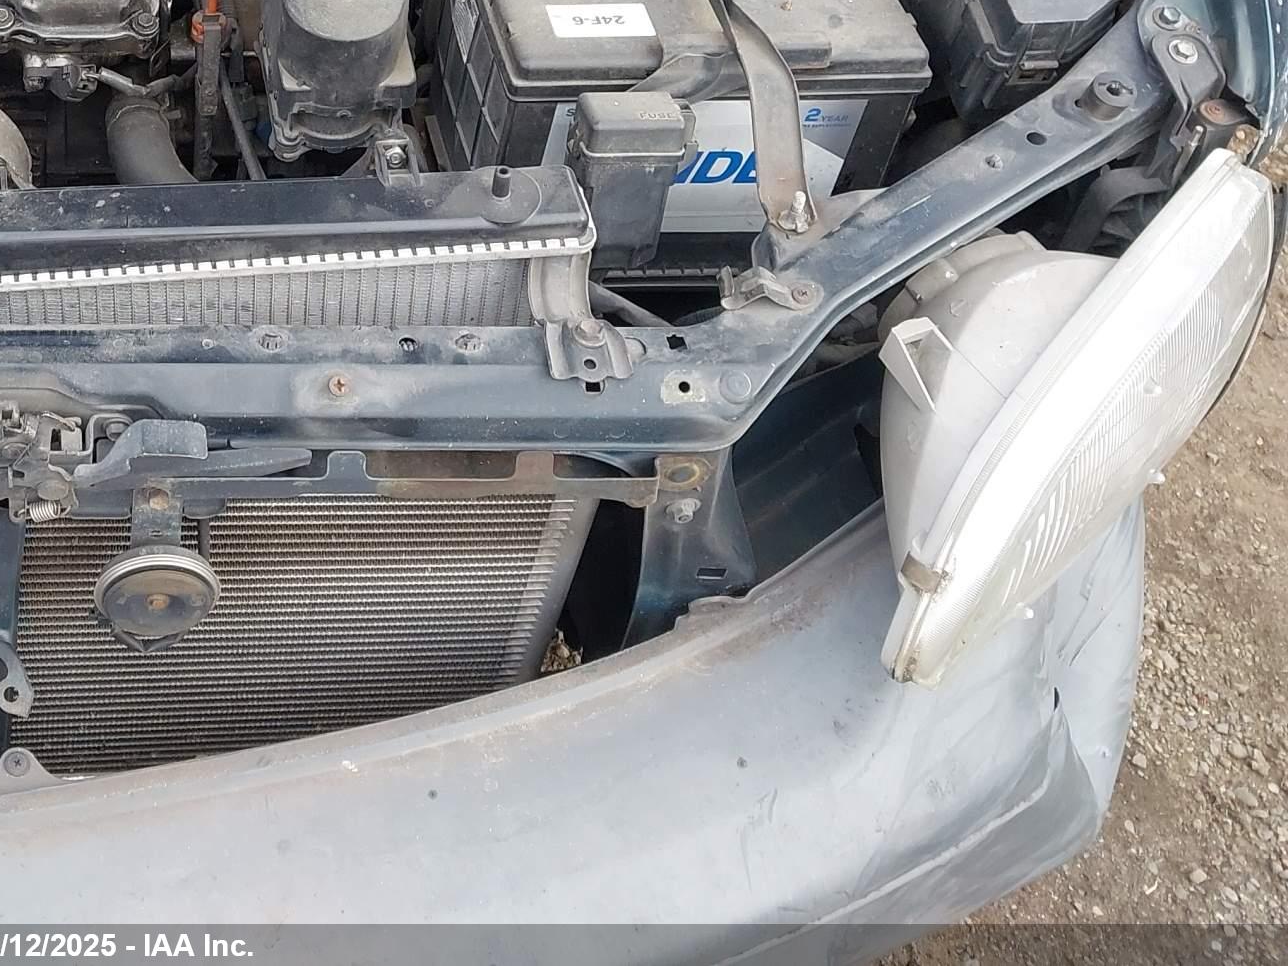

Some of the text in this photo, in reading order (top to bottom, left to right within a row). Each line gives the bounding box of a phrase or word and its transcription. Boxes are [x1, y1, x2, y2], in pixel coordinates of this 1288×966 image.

[571, 15, 625, 26] 24F-6
[639, 112, 677, 120] FUSE
[804, 107, 822, 122] 2
